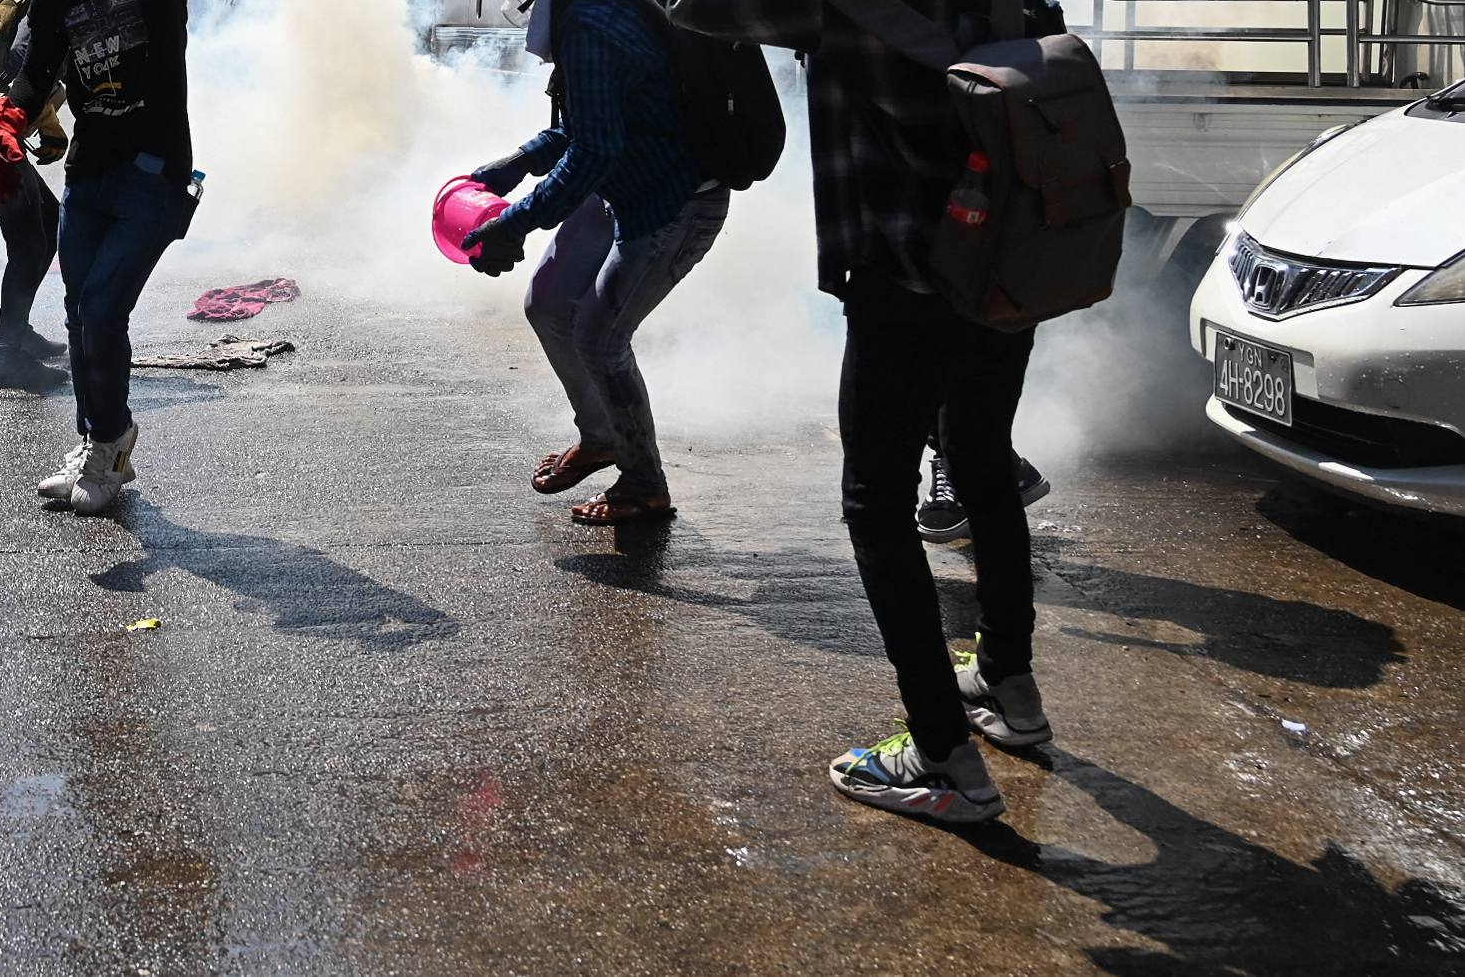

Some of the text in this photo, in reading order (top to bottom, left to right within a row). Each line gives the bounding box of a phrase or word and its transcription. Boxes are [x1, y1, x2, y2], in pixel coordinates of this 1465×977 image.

[74, 35, 120, 65] NEW
[1237, 343, 1263, 368] YGN
[1219, 359, 1286, 417] 4H-8298
